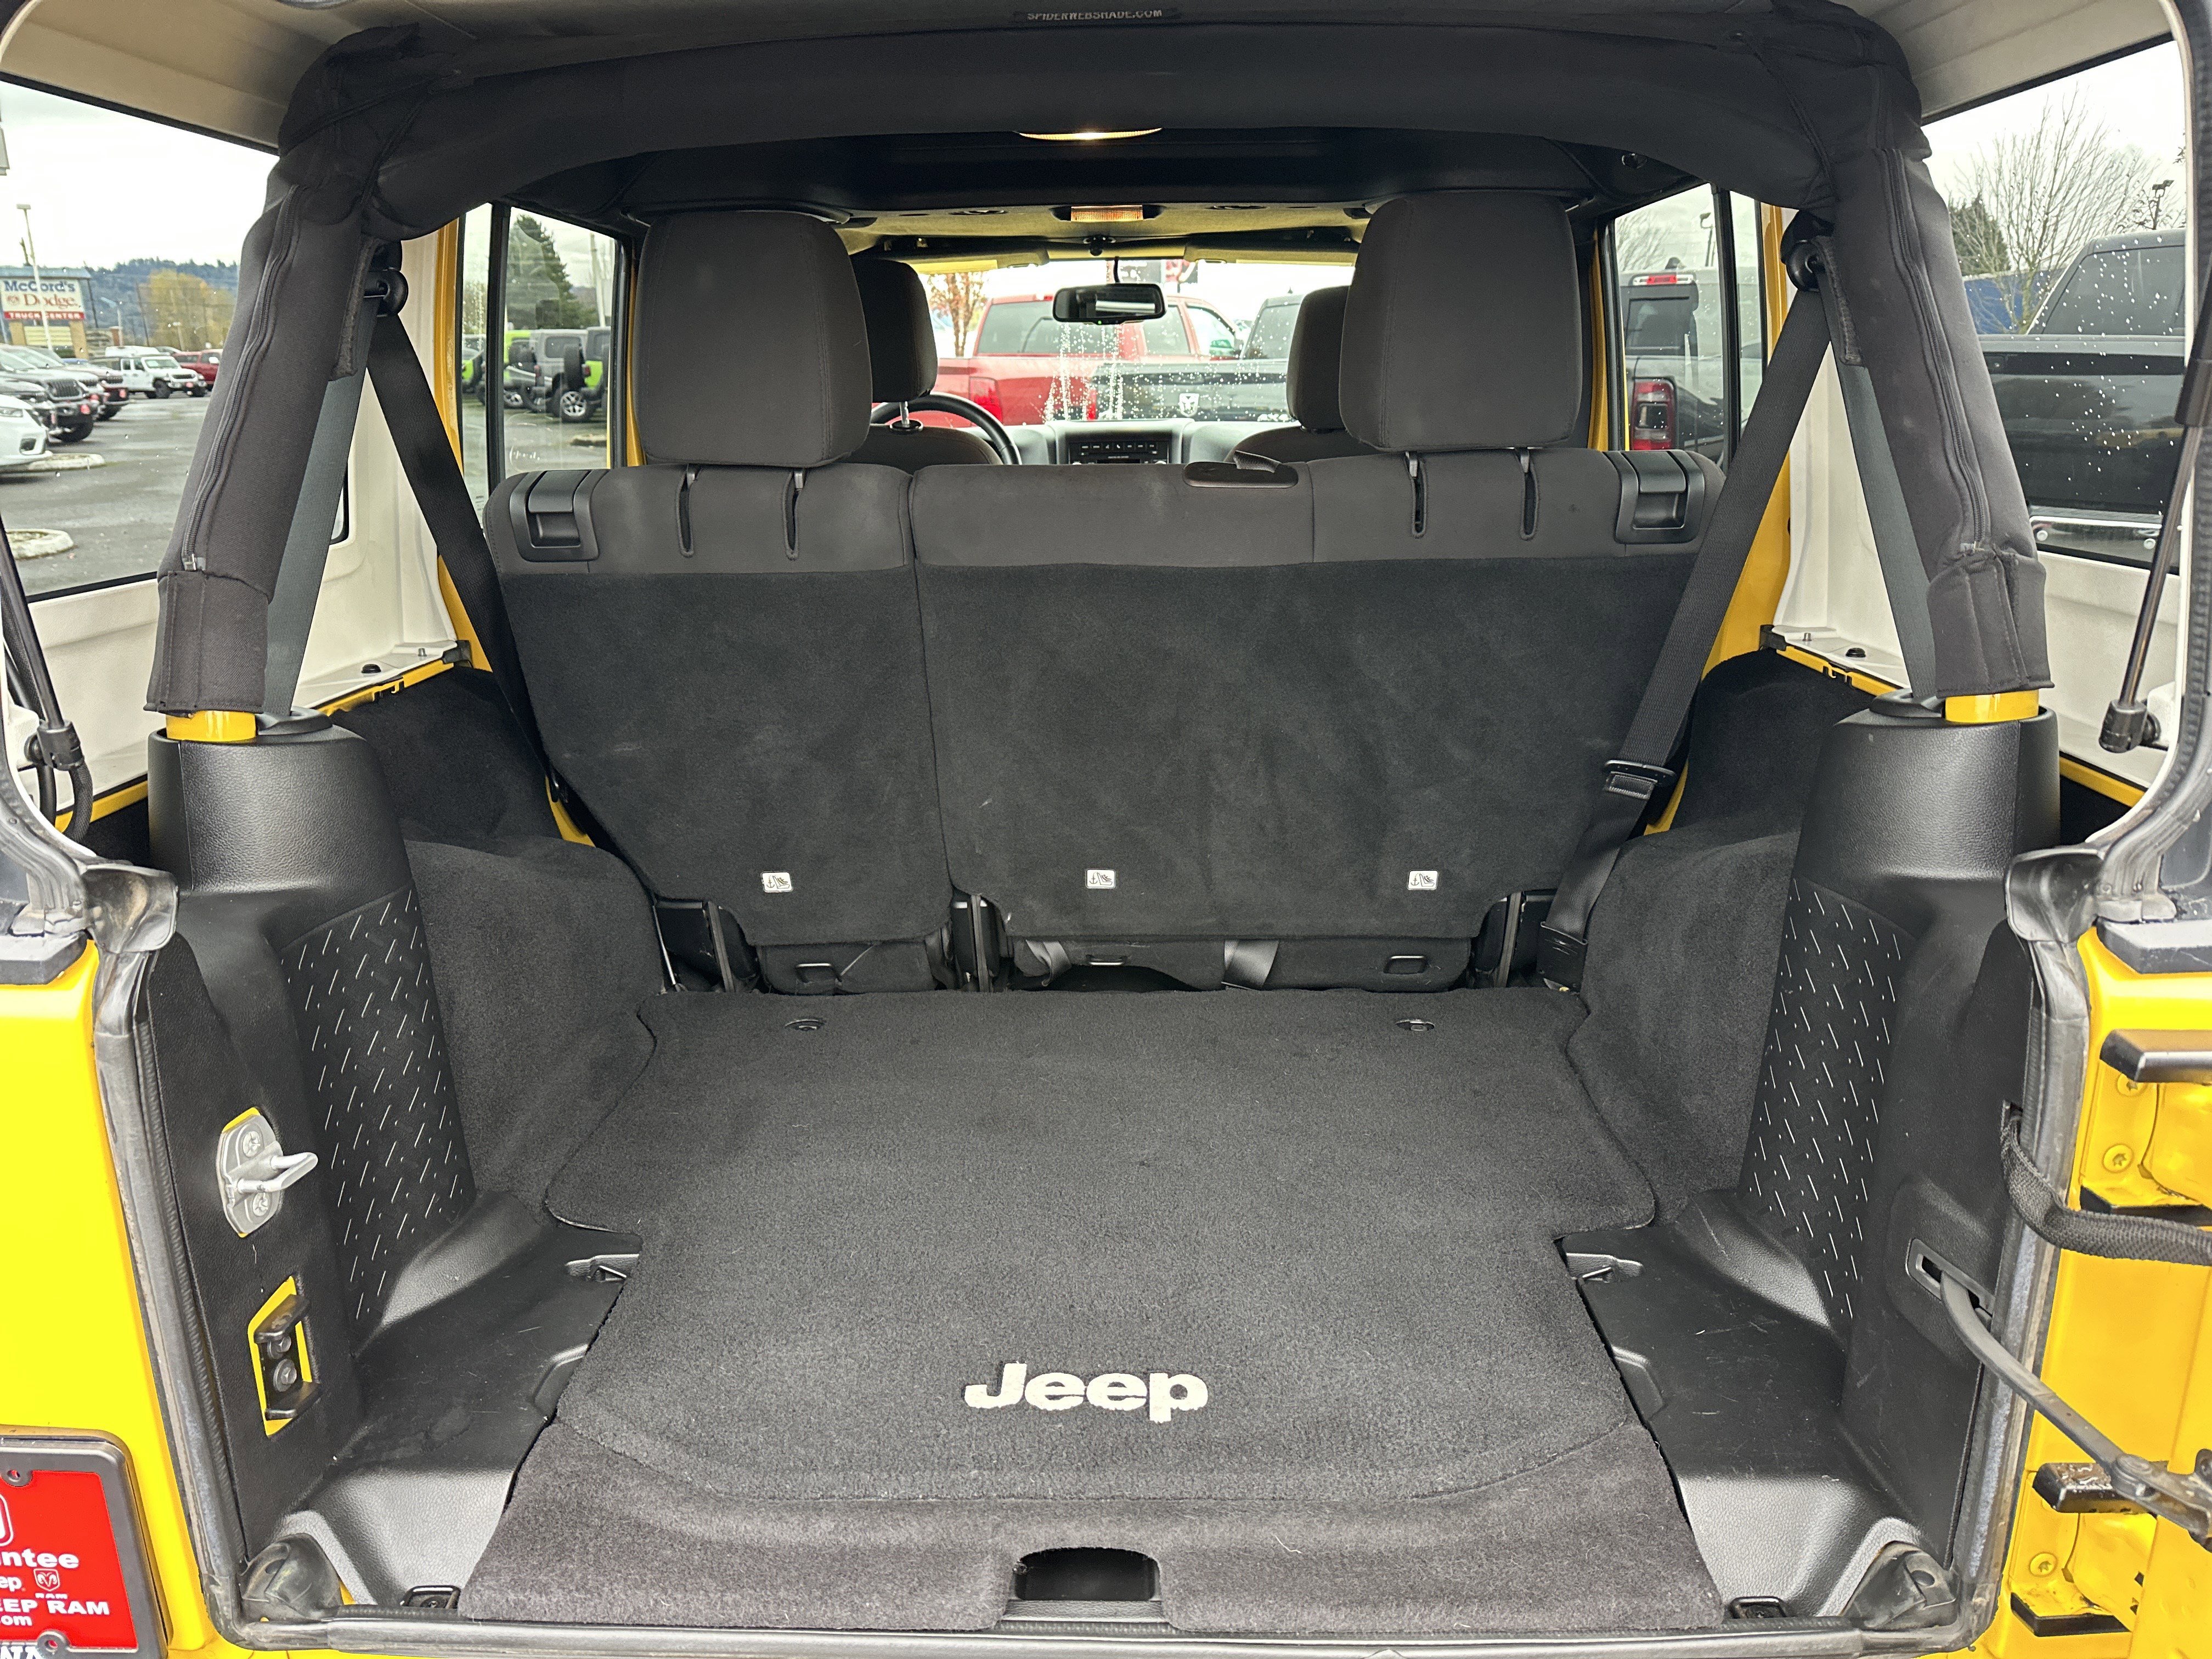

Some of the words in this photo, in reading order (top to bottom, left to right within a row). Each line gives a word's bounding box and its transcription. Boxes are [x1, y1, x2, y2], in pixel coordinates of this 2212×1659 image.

[1027, 10, 1163, 20] SPIDERWEBSHADE.COM
[4, 280, 75, 292] McCord's
[964, 1362, 1208, 1424] Jeep
[0, 1548, 79, 1568] ntee
[0, 1598, 38, 1613] EP
[47, 1600, 110, 1615] RAM
